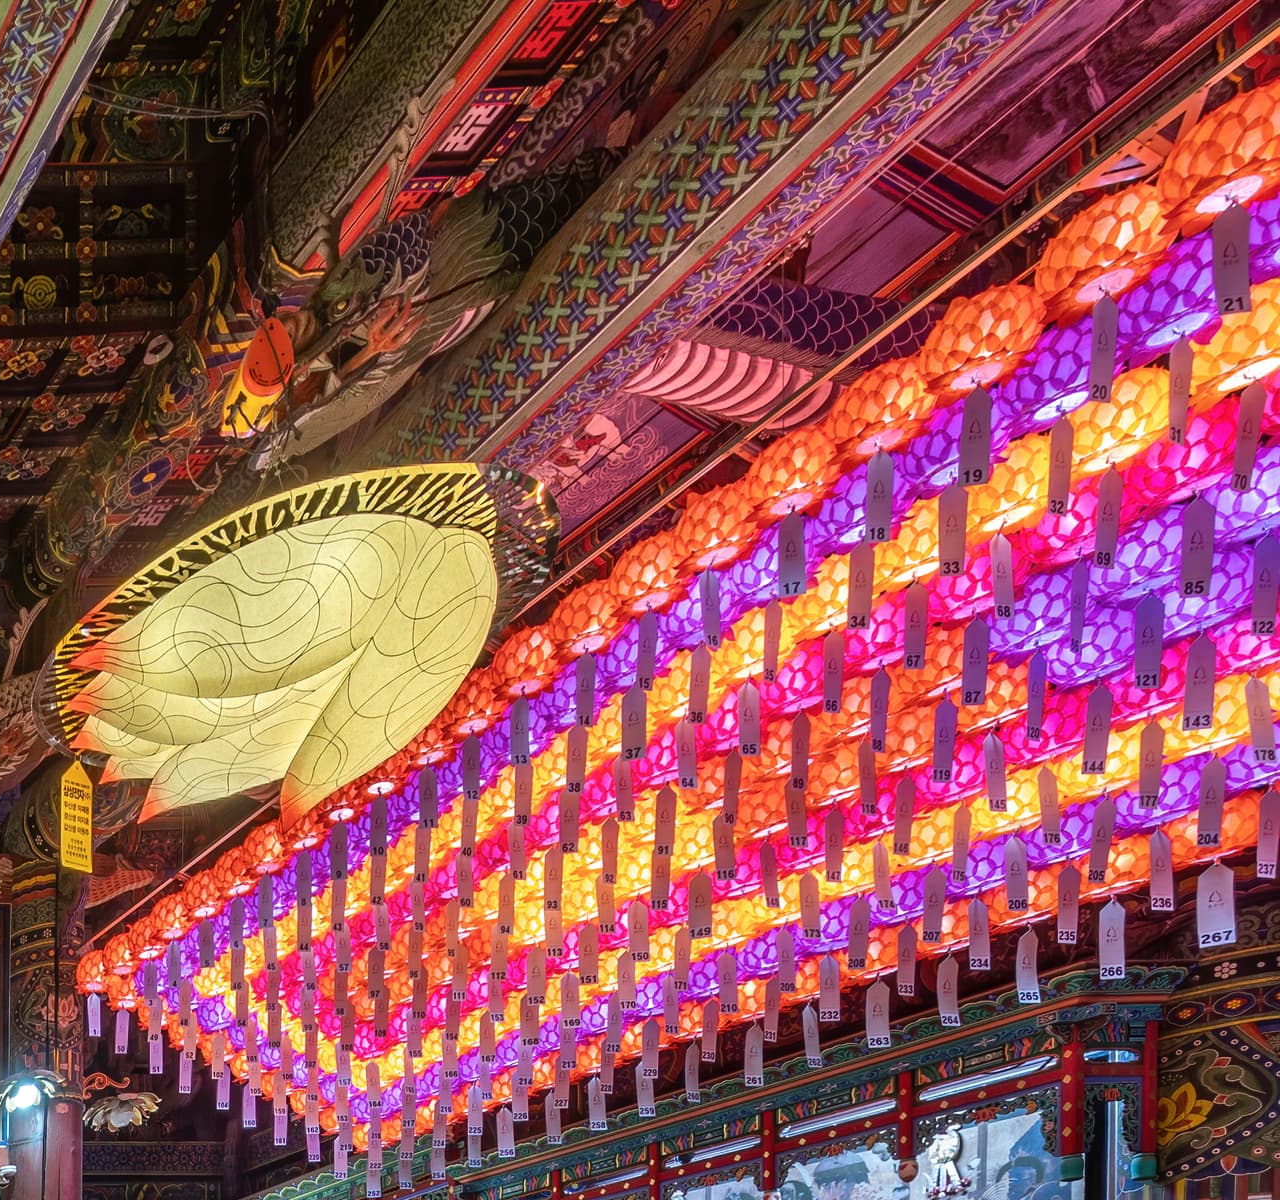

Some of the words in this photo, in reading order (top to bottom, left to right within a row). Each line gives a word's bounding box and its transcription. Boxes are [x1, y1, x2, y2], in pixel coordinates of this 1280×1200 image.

[1223, 296, 1244, 312] 21
[1092, 383, 1107, 400] 20
[1170, 426, 1182, 443] 31
[963, 469, 983, 484] 19
[1234, 473, 1248, 490] 70
[1050, 499, 1064, 514] 32
[869, 527, 885, 540] 18
[1096, 551, 1111, 566] 69
[943, 560, 960, 575] 33
[783, 581, 801, 595] 17
[1184, 580, 1205, 595] 85
[997, 605, 1011, 618] 68
[850, 615, 866, 628] 34
[1252, 620, 1274, 634] 122
[906, 654, 921, 668] 67
[1136, 673, 1157, 687] 121
[964, 690, 981, 704] 87
[825, 699, 838, 712] 66
[690, 711, 703, 723] 36
[1183, 714, 1211, 729] 143
[625, 746, 642, 759] 37
[742, 743, 757, 755] 65
[1254, 749, 1276, 761] 178
[514, 754, 528, 765] 13
[1084, 760, 1104, 772] 144
[932, 768, 951, 781] 119
[568, 782, 581, 793] 38
[466, 789, 478, 800] 12
[1140, 794, 1158, 807] 177
[423, 818, 434, 828] 11
[790, 835, 808, 847] 117
[1197, 832, 1219, 845] 204
[372, 845, 385, 856] 10
[716, 866, 735, 880] 116
[1258, 863, 1275, 875] 237
[1008, 898, 1028, 910] 206
[1152, 897, 1172, 908] 236
[689, 926, 711, 938] 149
[922, 931, 940, 942] 207
[1058, 930, 1076, 941] 235
[1201, 930, 1233, 945] 267
[970, 958, 989, 968] 234
[1101, 966, 1123, 977] 266
[1019, 991, 1039, 1001] 265
[821, 1010, 839, 1020] 232
[869, 1037, 890, 1046] 263
[116, 1045, 126, 1053] 50
[746, 1076, 762, 1085] 261
[243, 1119, 257, 1128] 160
[499, 1148, 516, 1157] 256
[366, 1190, 382, 1198] 252
